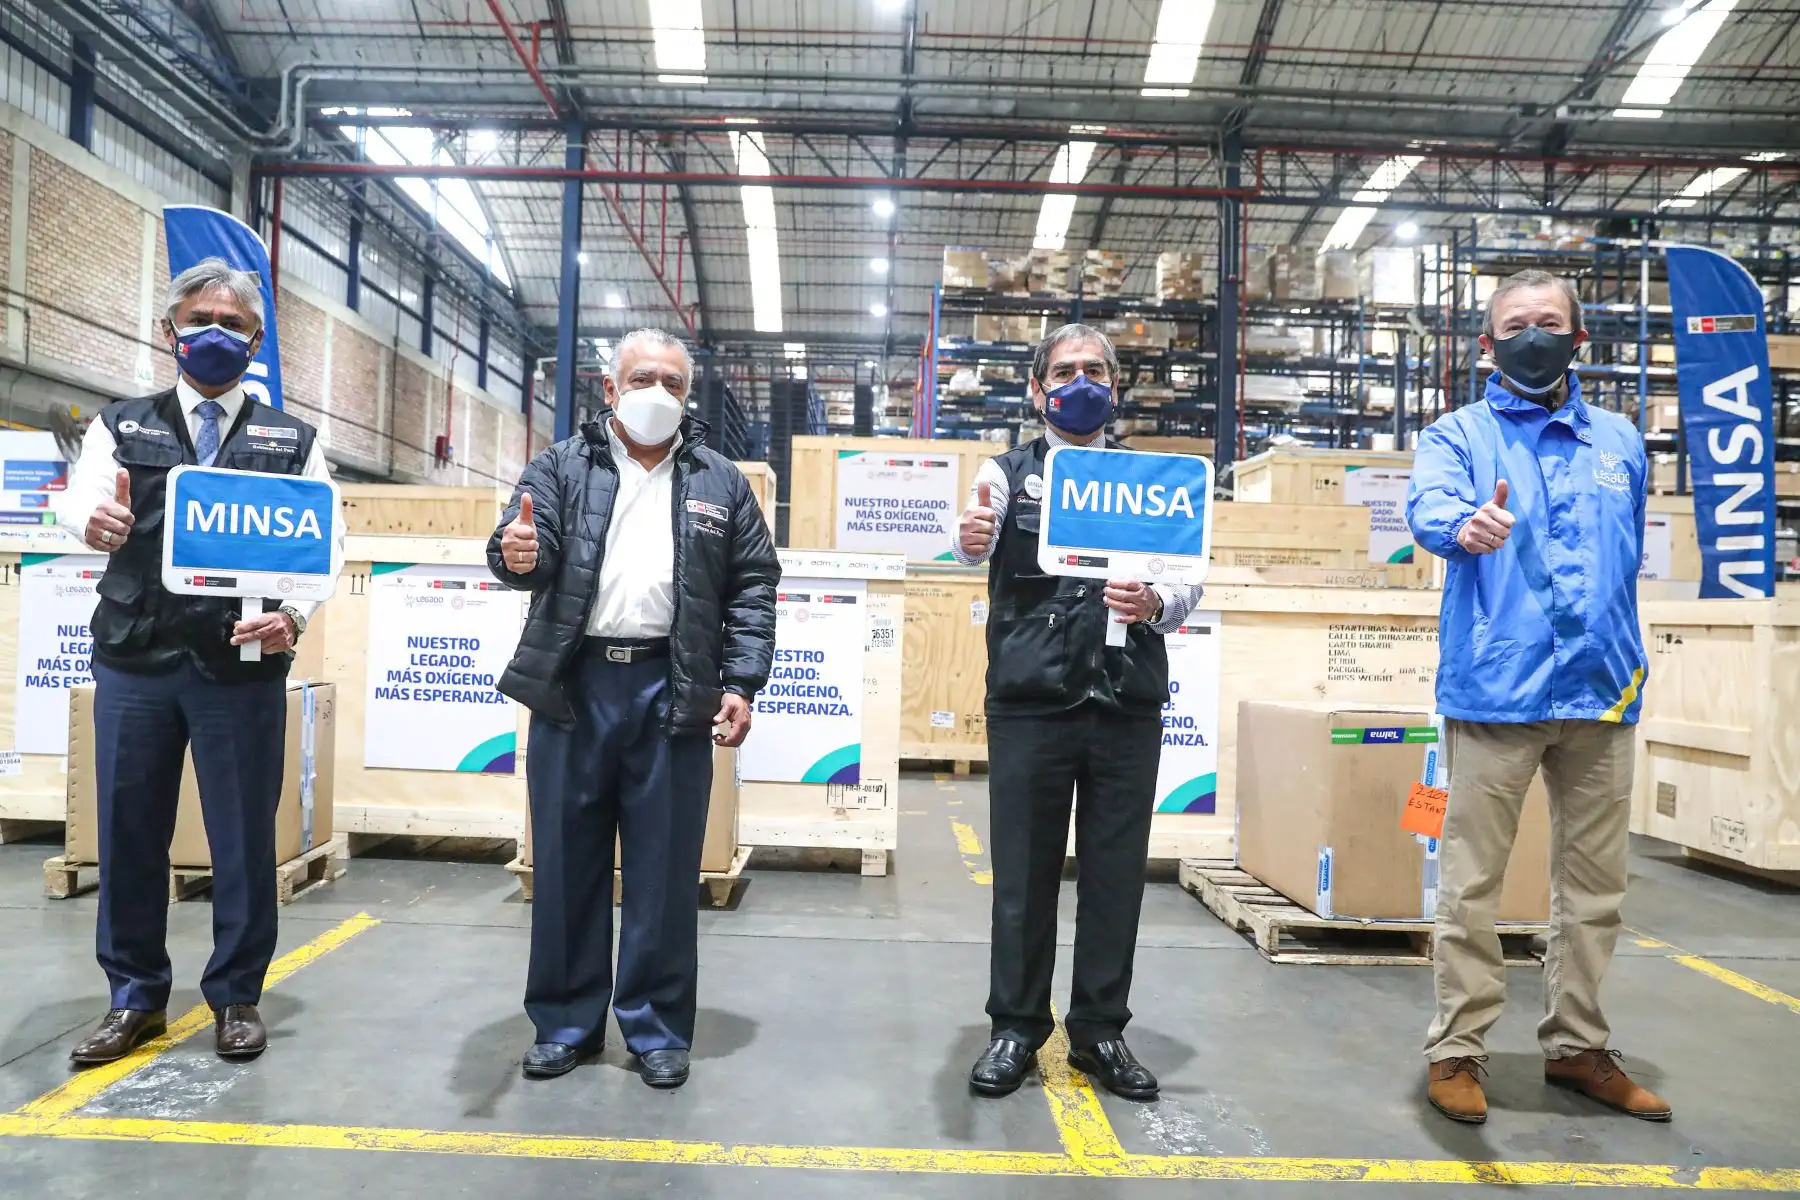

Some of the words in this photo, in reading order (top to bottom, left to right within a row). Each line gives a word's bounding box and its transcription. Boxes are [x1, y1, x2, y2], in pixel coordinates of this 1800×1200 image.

[845, 497, 899, 508] NUESTRO
[901, 499, 950, 510] LEGADO:
[1062, 479, 1195, 519] MINSA
[187, 500, 322, 539] MINSA
[855, 508, 882, 520] MÁS
[884, 509, 938, 522] OXÍGENO,
[847, 520, 873, 532] MÁS
[875, 522, 946, 534] ESPERANZA.
[778, 558, 793, 566] dm
[1328, 624, 1388, 632] ESTANTERIAS
[407, 635, 480, 651] NUESTRO
[1328, 632, 1356, 640] CALLE
[410, 653, 476, 668] LEGADO:
[774, 649, 825, 663] ESTRO
[1328, 649, 1351, 657] LIMA
[37, 656, 71, 672] MÁS
[25, 672, 60, 688] MÁS
[387, 667, 422, 683] MÁS
[425, 669, 498, 687] OXÍGENO,
[769, 666, 820, 681] GADO:
[375, 684, 410, 701] MÁS
[413, 688, 508, 704] ESPERANZA.
[769, 681, 843, 701] OXÍGENO,
[757, 701, 853, 716] ESPERANZA.
[1161, 733, 1209, 747] ANZA.
[1370, 730, 1399, 740] Talma
[1426, 752, 1435, 786] NOVAIR
[857, 796, 868, 804] HT
